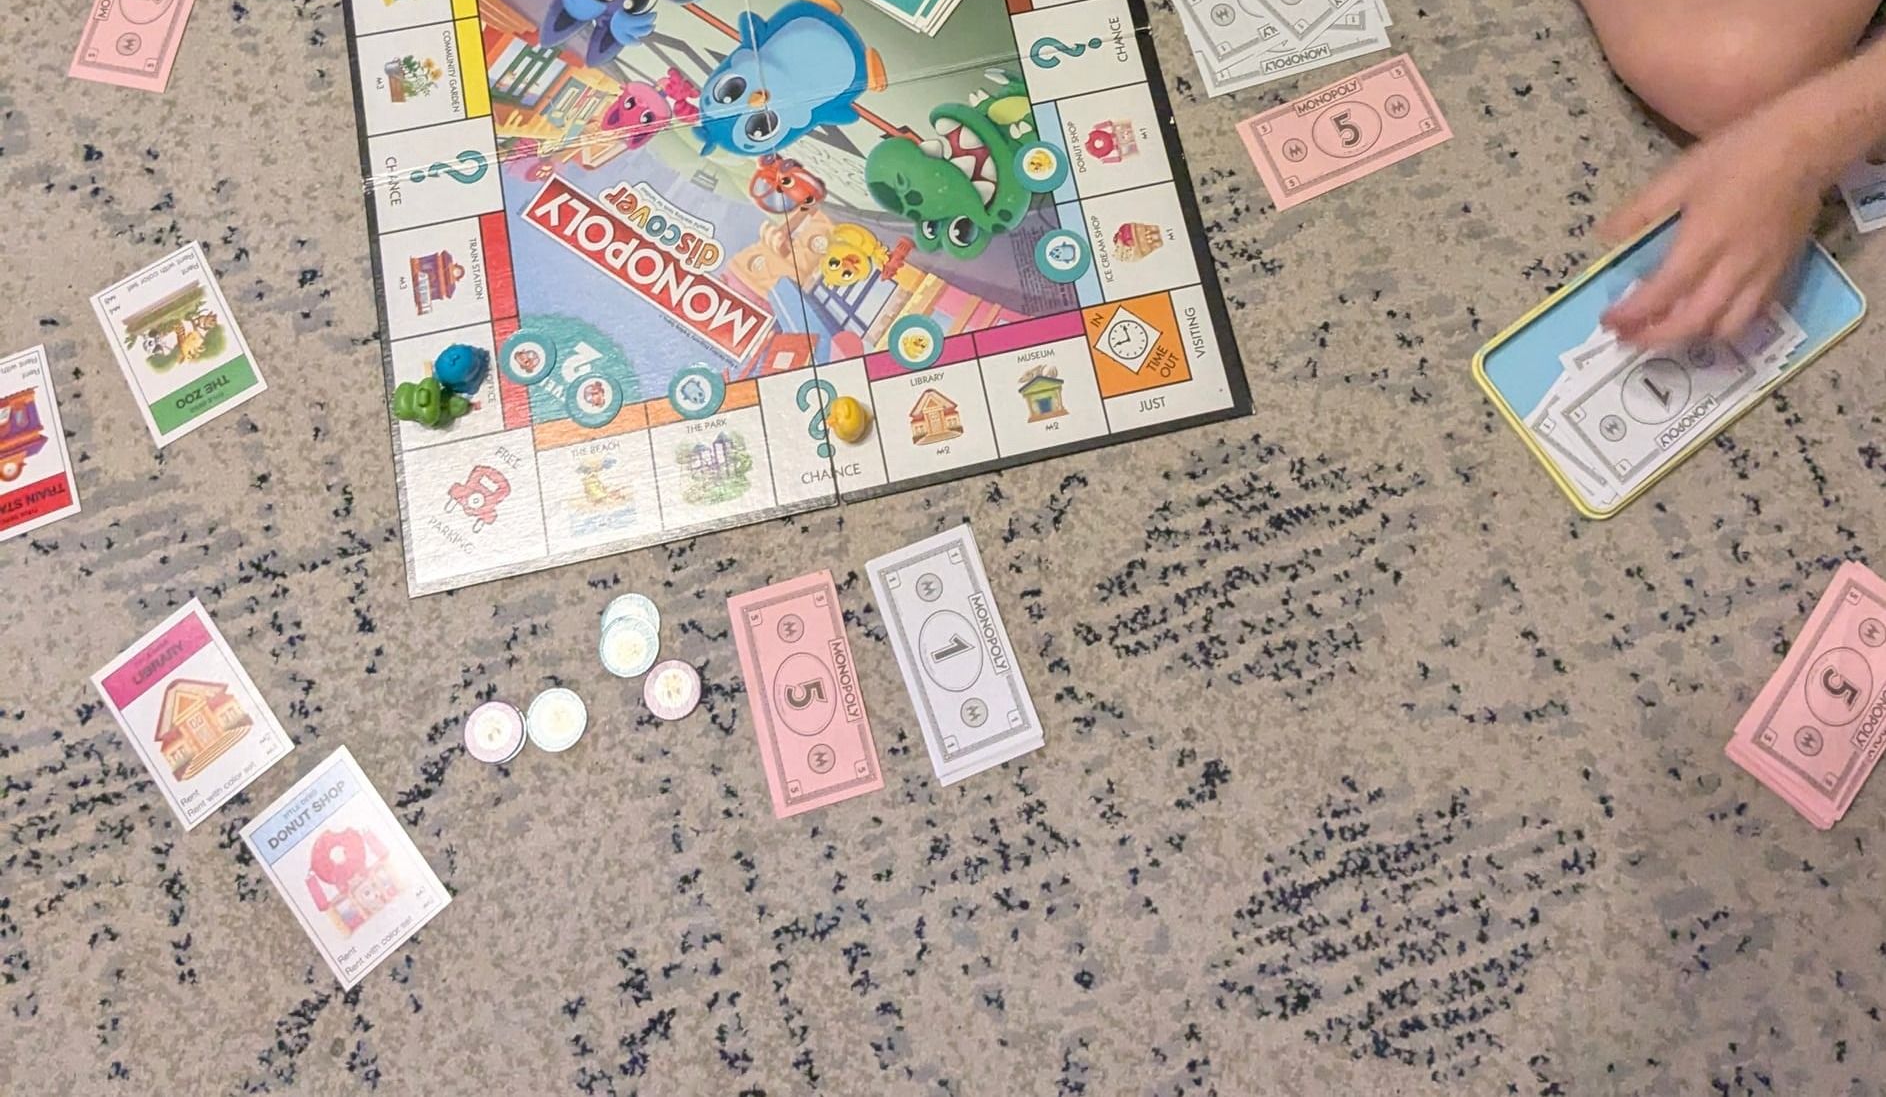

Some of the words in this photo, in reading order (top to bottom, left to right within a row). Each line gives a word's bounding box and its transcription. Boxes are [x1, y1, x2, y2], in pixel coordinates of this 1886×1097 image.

[1109, 16, 1128, 62] CHANCE
[442, 31, 456, 77] COMMUNITY
[449, 78, 460, 113] GARDEN
[1263, 46, 1329, 73] MONOPOLY
[1295, 81, 1359, 114] MONOPOLY
[1067, 121, 1080, 144] SHOP
[1331, 111, 1360, 146] 5
[1073, 147, 1087, 173] DONUT
[603, 186, 721, 269] discover
[1091, 216, 1103, 239] SHOP
[469, 237, 479, 263] TRAIN
[1098, 239, 1111, 267] CREAM
[472, 264, 484, 300] STATION
[534, 192, 758, 348] MONOPOLY
[1104, 268, 1115, 282] ICE
[1090, 313, 1105, 327] IN
[1184, 307, 1206, 359] VISITING
[1016, 349, 1055, 364] MUSEUM
[1145, 345, 1169, 373] TIME
[1160, 353, 1179, 378] OUT
[203, 374, 230, 395] THE
[909, 372, 945, 388] LIBRARY
[175, 390, 203, 410] ZOO
[1138, 396, 1166, 413] JUST
[1643, 377, 1672, 412] 1
[686, 424, 703, 434] THE
[704, 418, 728, 429] PARK
[1660, 398, 1715, 449] MONOPOLY
[801, 463, 862, 485] CHANCE
[23, 481, 66, 504] TRAIN
[932, 634, 976, 662] 1
[972, 596, 1008, 672] MONOPOLY
[131, 640, 185, 687] LIBRARY
[785, 678, 829, 710] 5
[832, 641, 861, 720] MONOPOLY
[1822, 667, 1860, 711] 5
[267, 808, 311, 852] DONUT
[310, 779, 347, 812] SHOP
